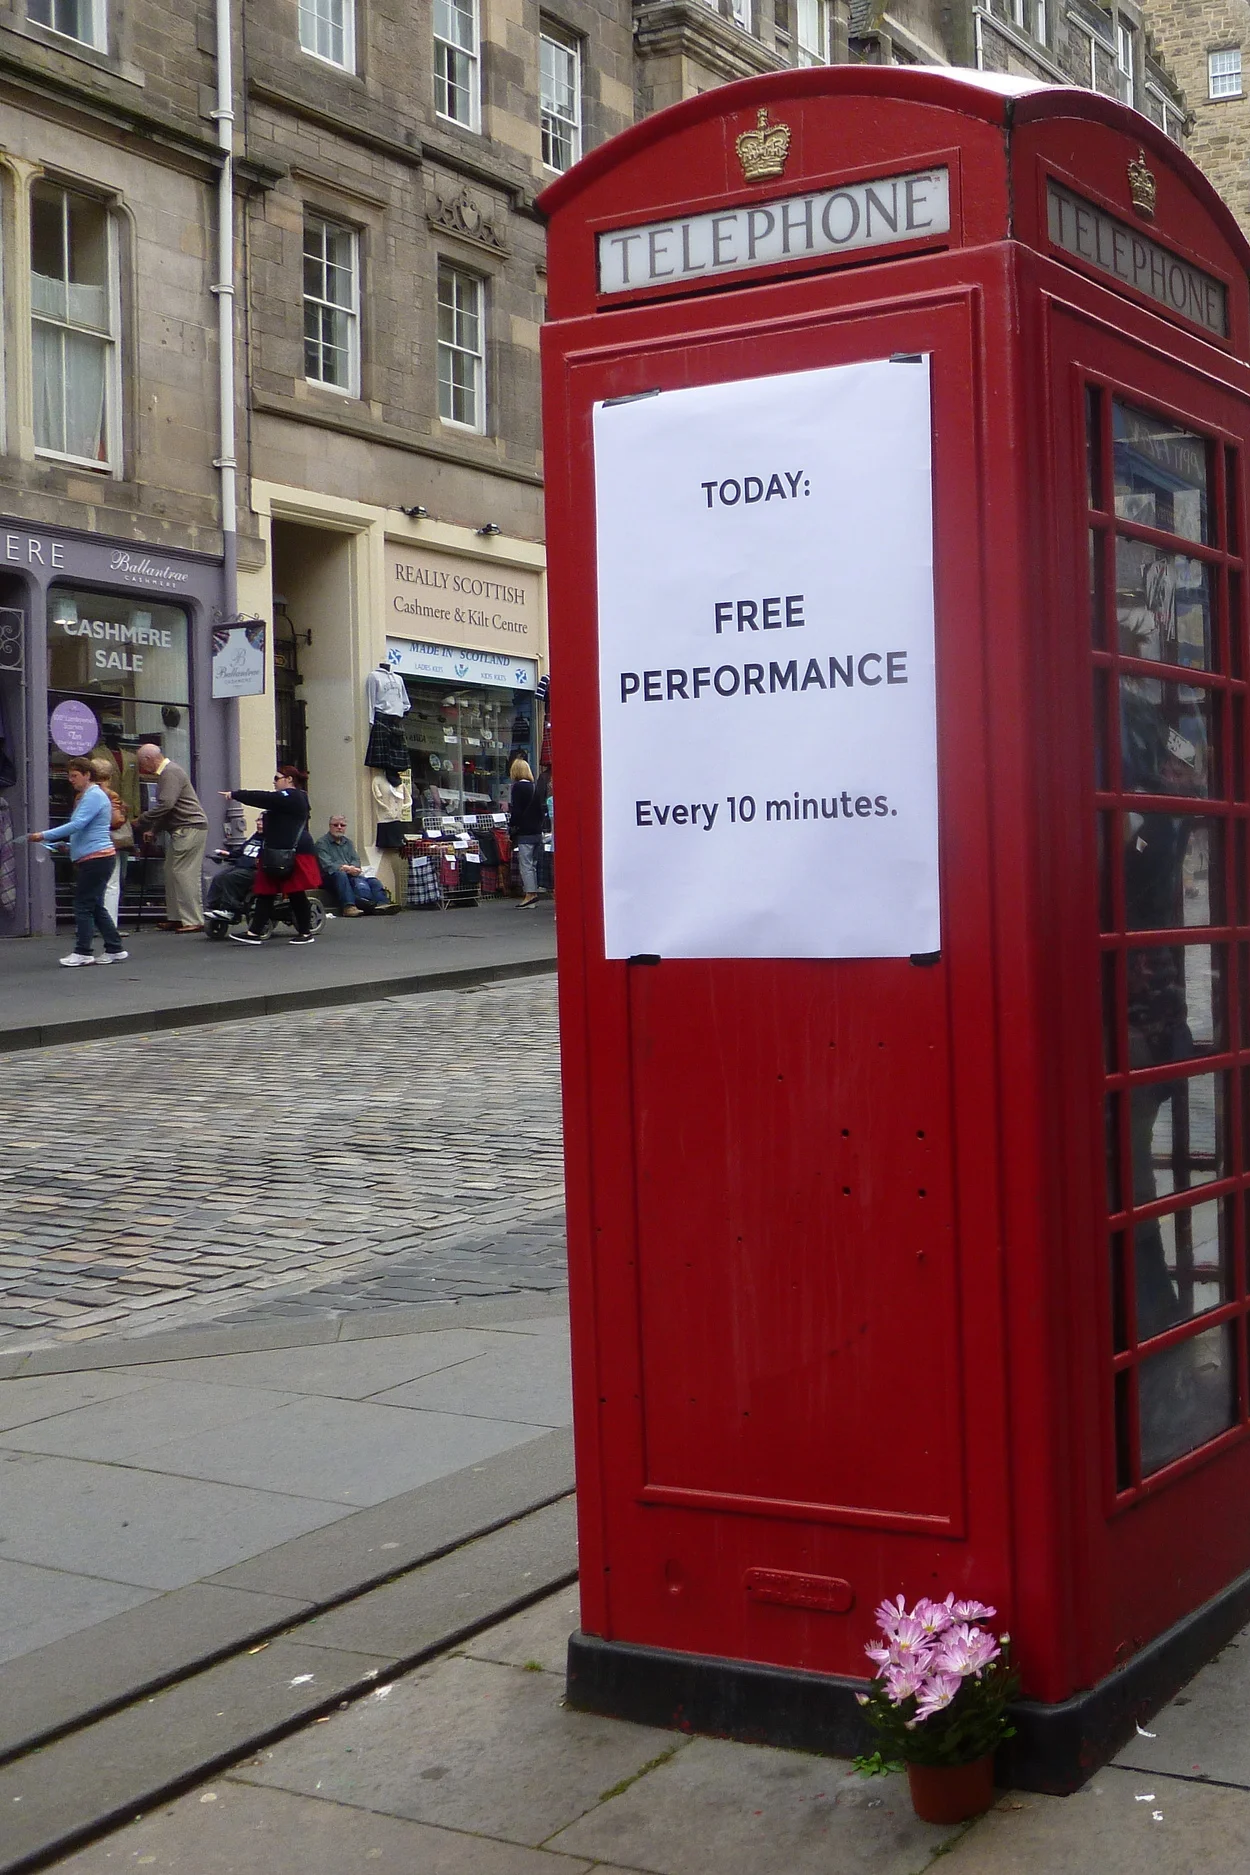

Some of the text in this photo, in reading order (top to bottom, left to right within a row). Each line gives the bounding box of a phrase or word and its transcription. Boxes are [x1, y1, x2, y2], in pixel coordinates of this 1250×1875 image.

[610, 175, 935, 285] TELEPHONE
[1049, 188, 1219, 329] TELEPHONE
[700, 470, 811, 509] TODAY:
[109, 549, 189, 583] Ballantrae
[124, 574, 177, 589] CASHMERE
[395, 563, 526, 605] REALLY SCOTTISH
[63, 618, 172, 648] CASHMERE
[393, 596, 528, 634] Cashmere & Kilt Centre
[714, 594, 806, 635] FREE
[95, 650, 144, 673] SALE
[215, 666, 260, 679] Ballantrae
[409, 642, 511, 667] MADE IN SCOTLAND
[619, 651, 909, 704] PERFORMANCE
[635, 790, 898, 831] Every 10 minutes.
